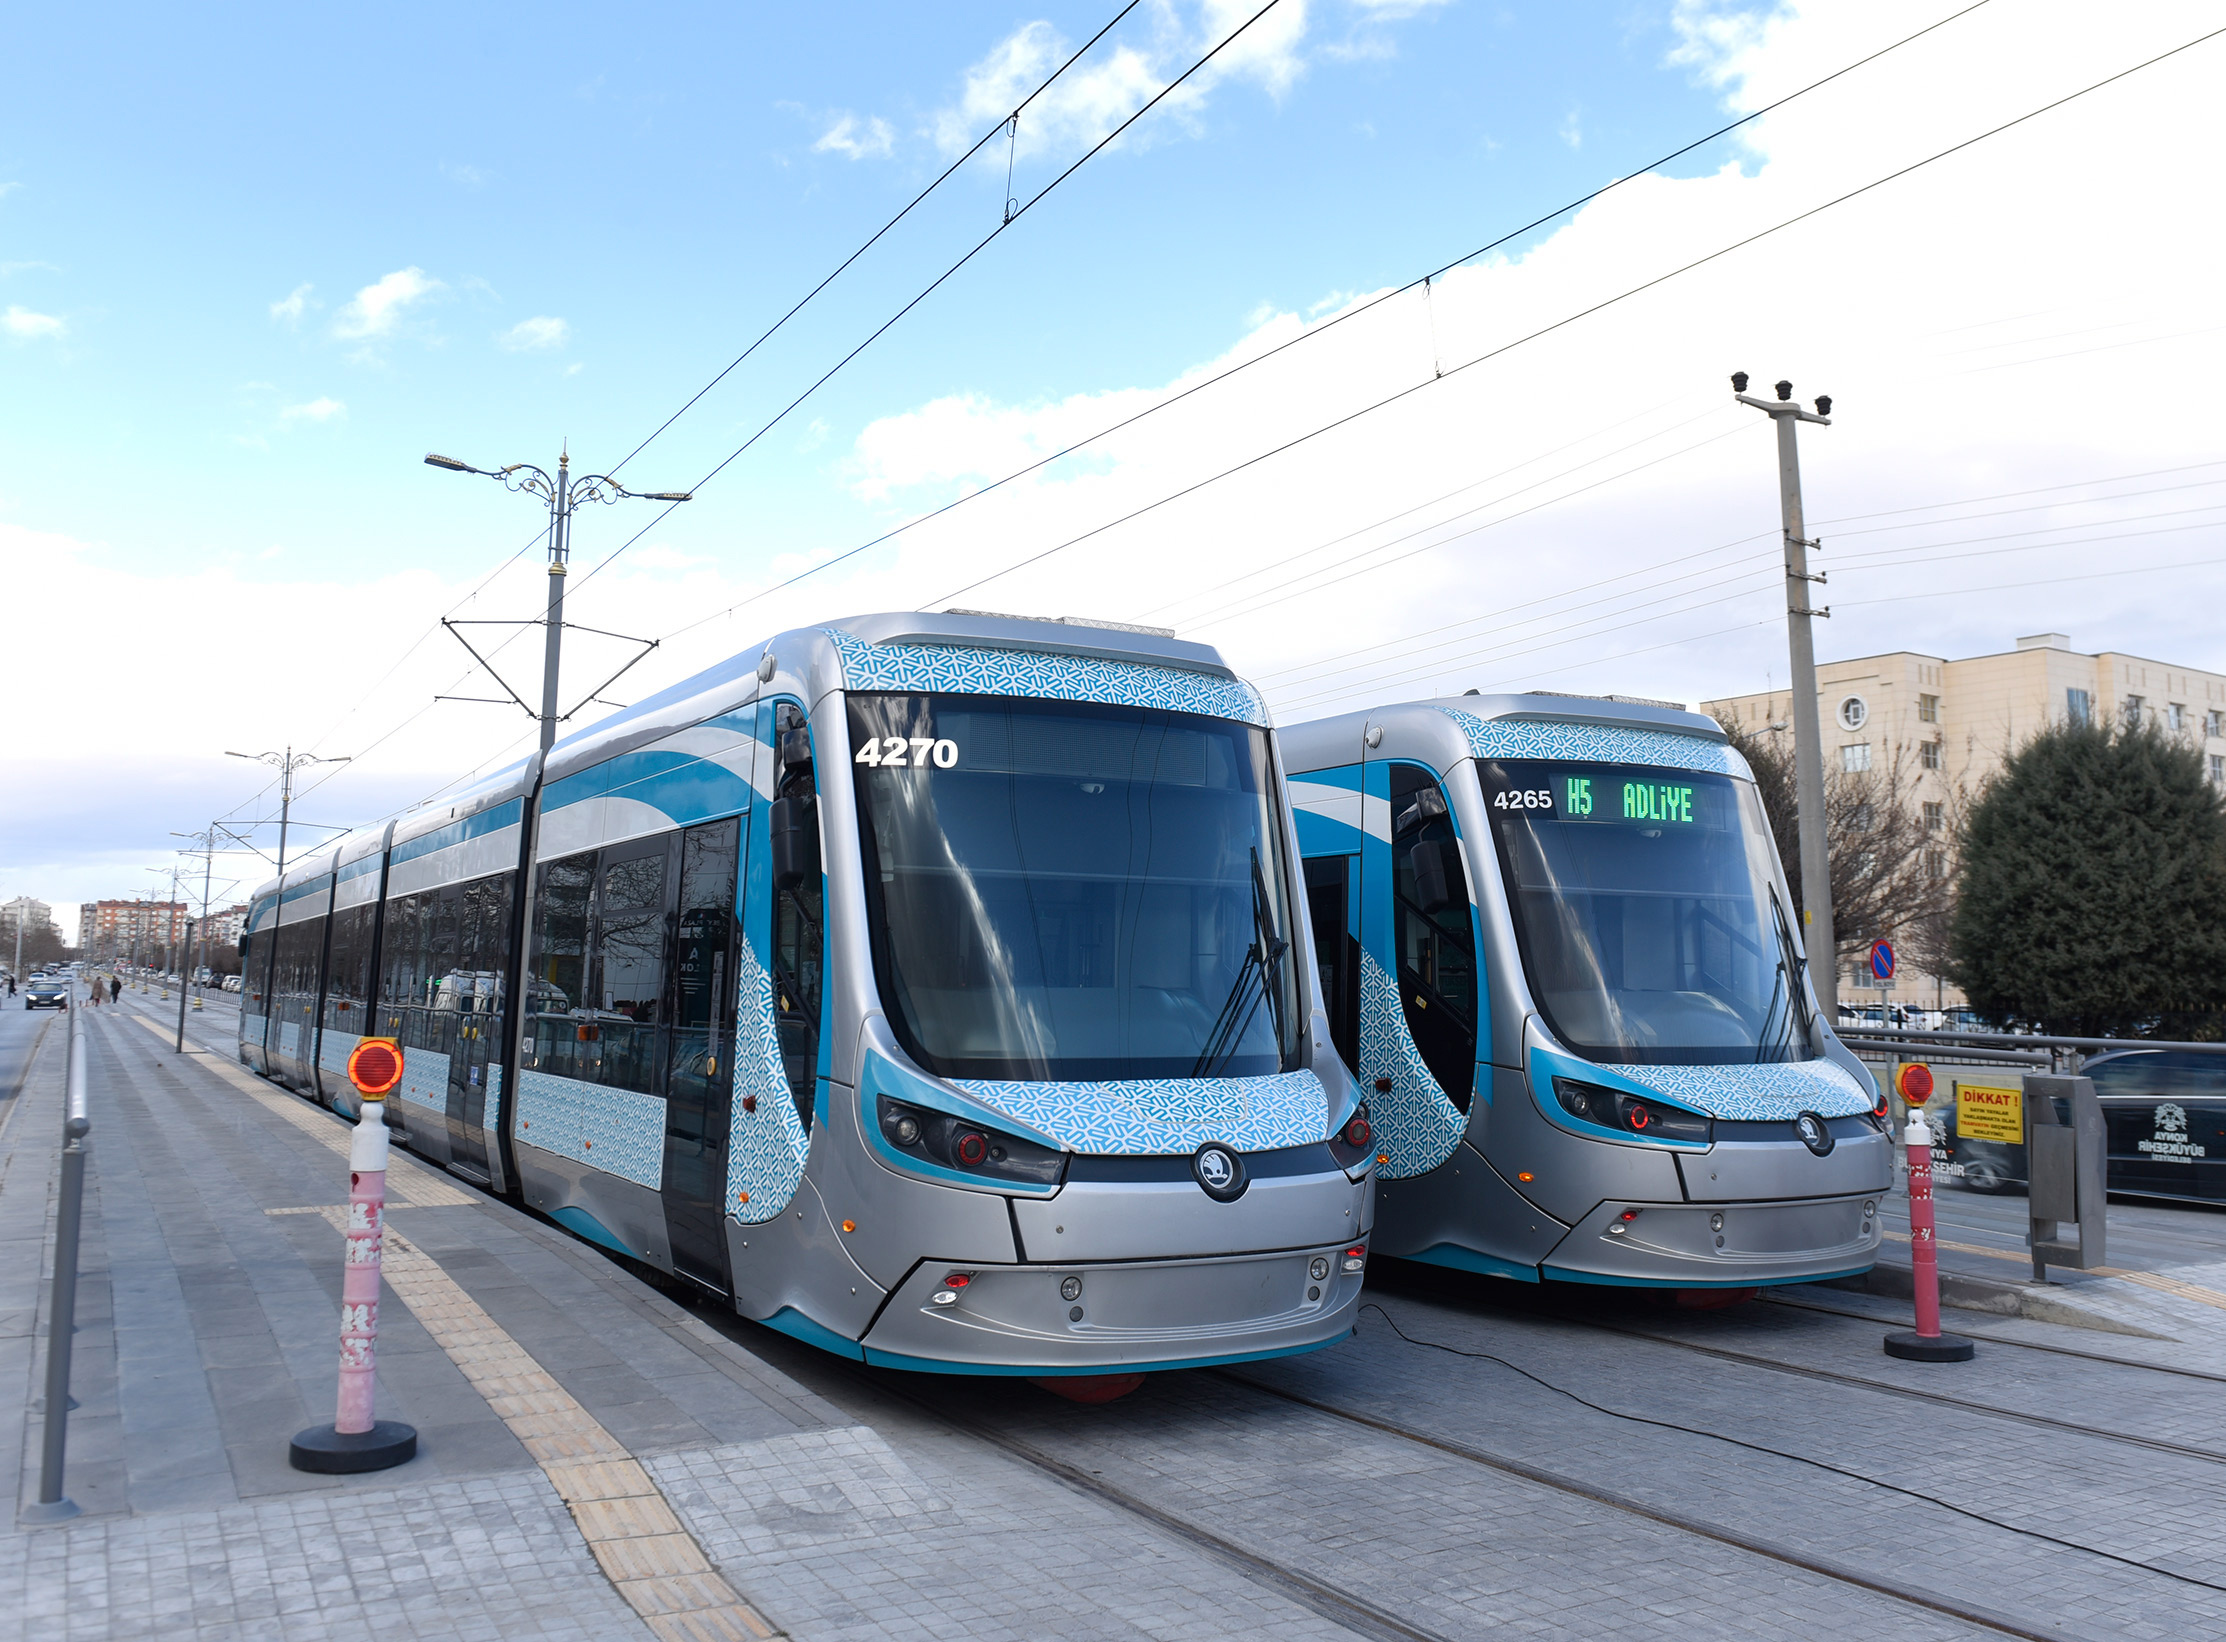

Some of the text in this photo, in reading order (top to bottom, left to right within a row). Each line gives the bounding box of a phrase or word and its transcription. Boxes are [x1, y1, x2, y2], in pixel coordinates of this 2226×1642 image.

[855, 737, 959, 768] 4270
[1494, 790, 1553, 810] 4265
[1567, 778, 1593, 815] H5
[1964, 1089, 2011, 1106] DİKKAT
[1929, 1148, 1948, 1160] NYA
